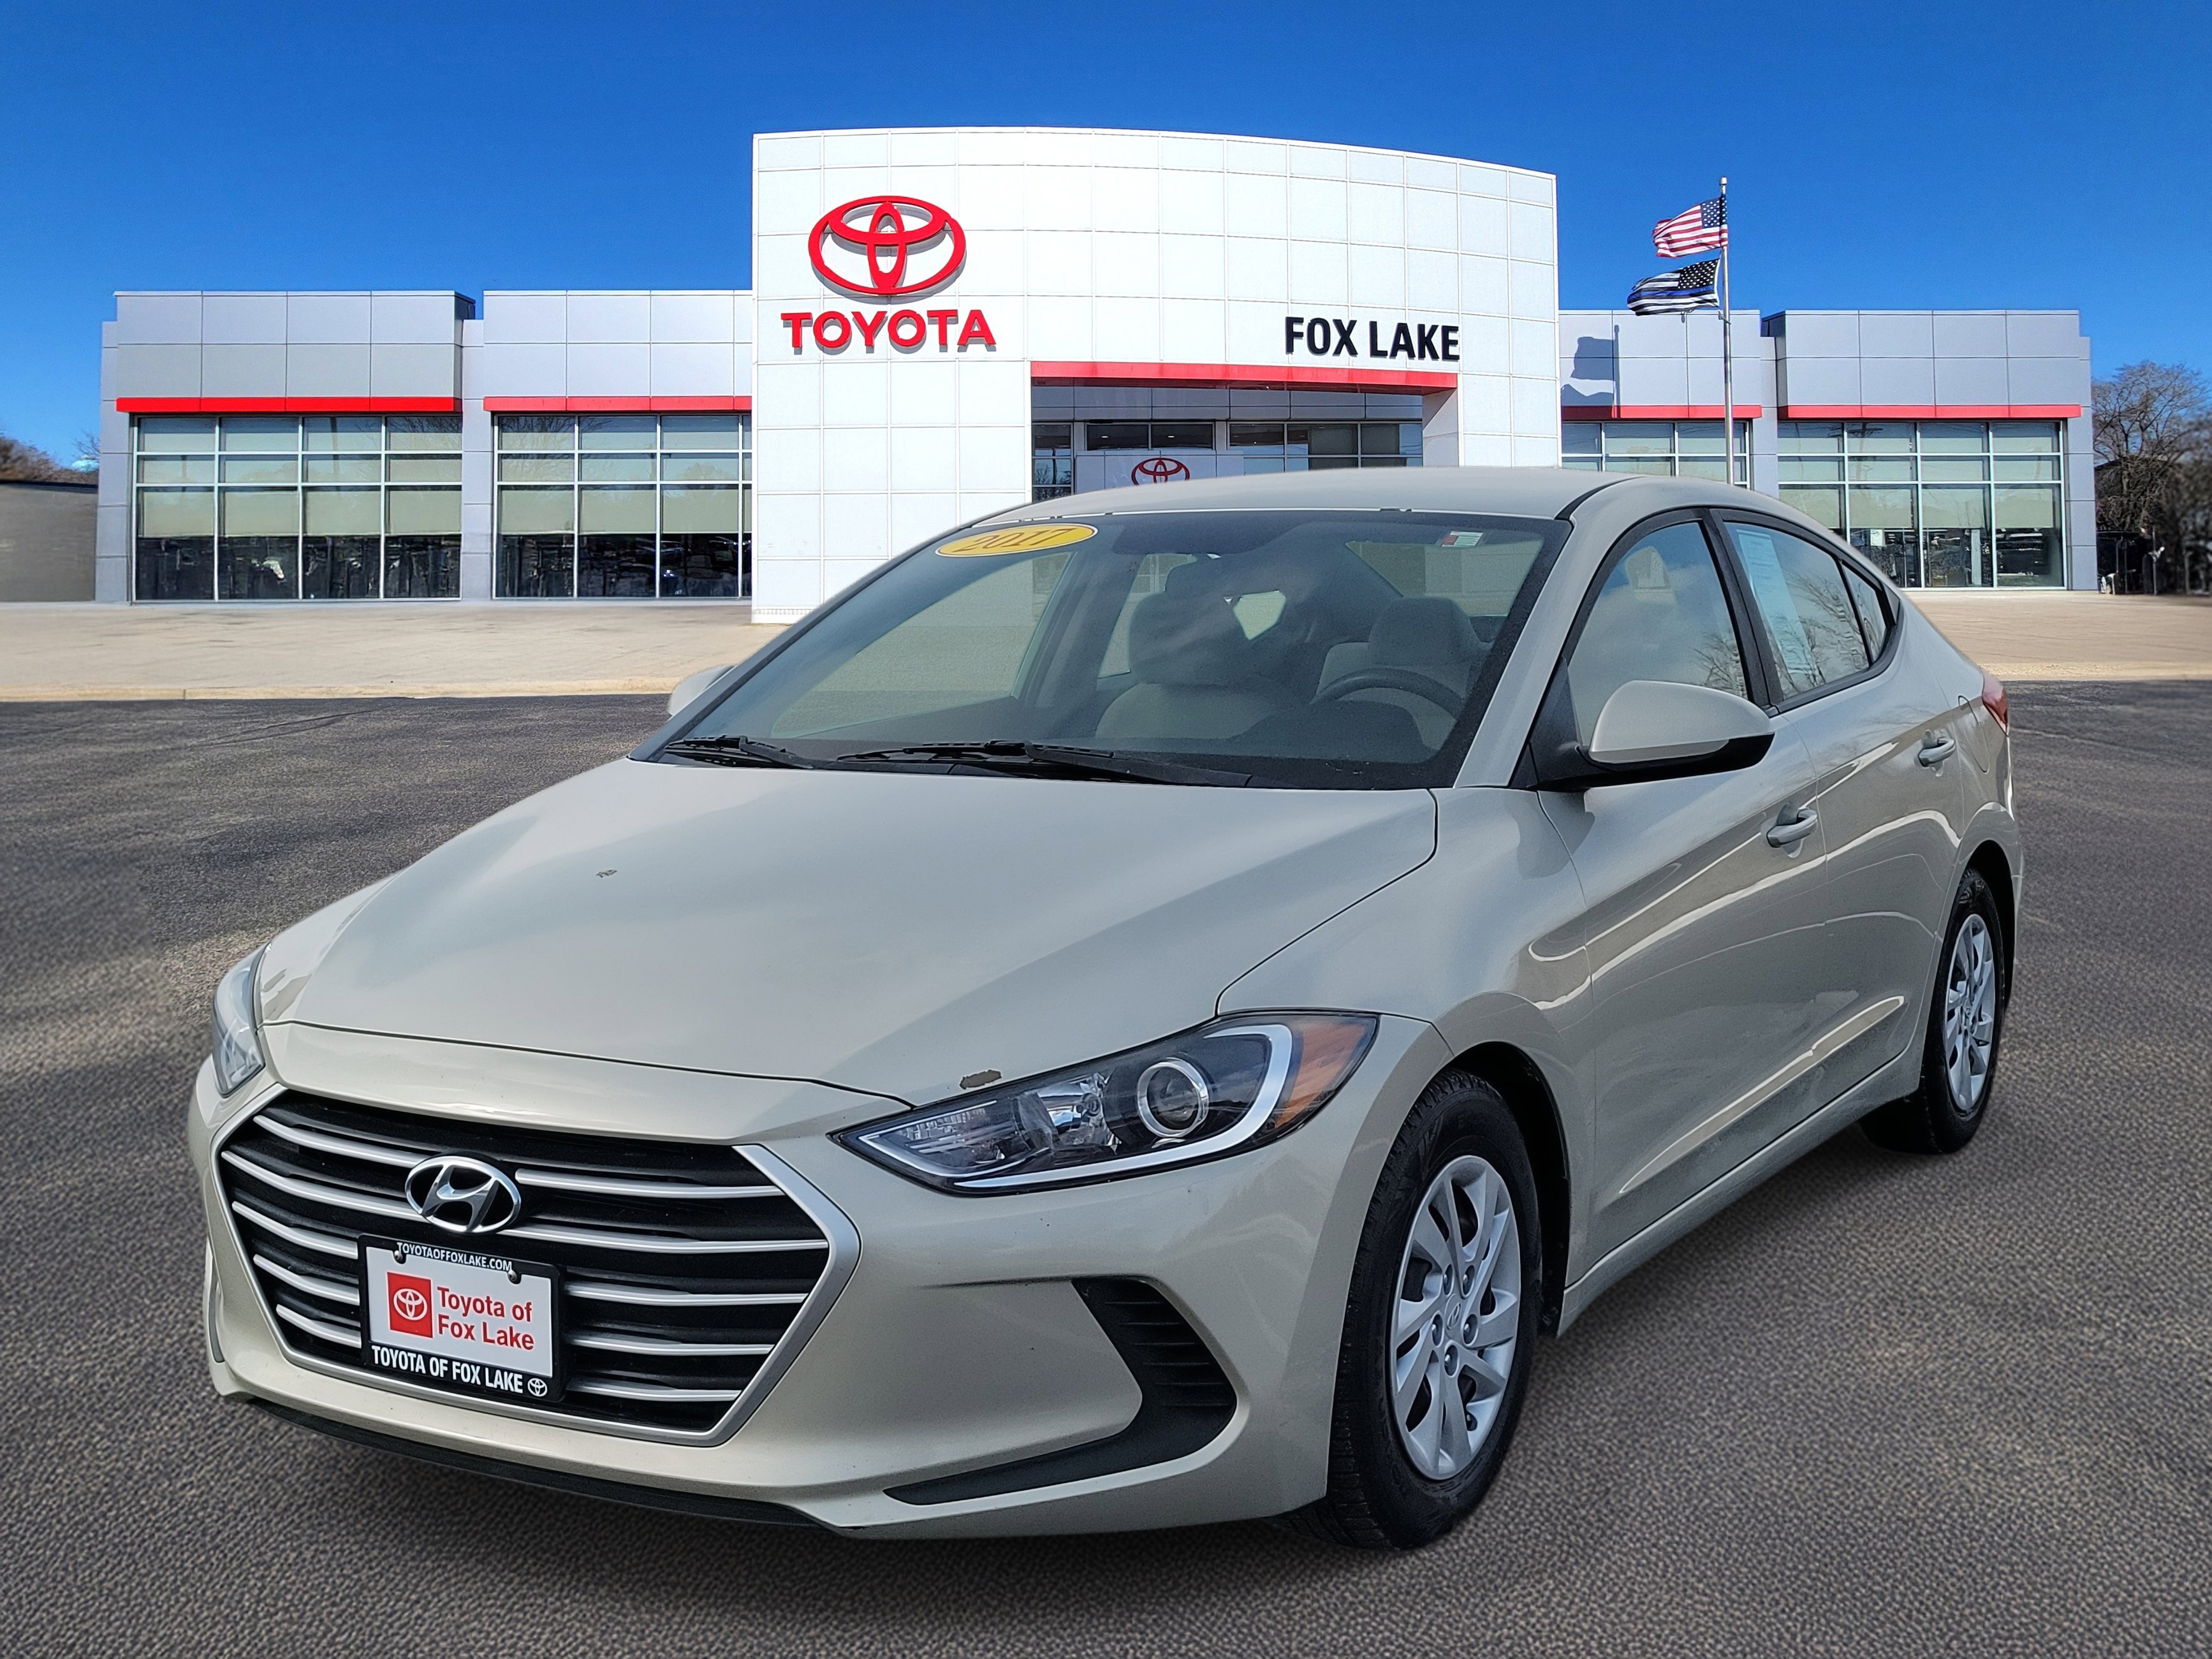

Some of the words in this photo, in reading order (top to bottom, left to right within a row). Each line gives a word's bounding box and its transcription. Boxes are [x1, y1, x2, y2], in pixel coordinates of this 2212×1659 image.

[781, 309, 997, 349] TOYOTA
[1285, 316, 1358, 356] FOX
[1369, 321, 1460, 361] LAKE
[951, 527, 1078, 553] 2017
[397, 1241, 512, 1271] TOYOTAOFFOXLAKE.COM
[437, 1286, 505, 1317] Toyota
[511, 1301, 532, 1322] of
[437, 1313, 476, 1341] Fox
[482, 1321, 534, 1350] Lake
[371, 1345, 426, 1374] TOYOTA
[429, 1357, 449, 1378] OF
[452, 1361, 481, 1385] FOX
[485, 1368, 524, 1394] LAKE
